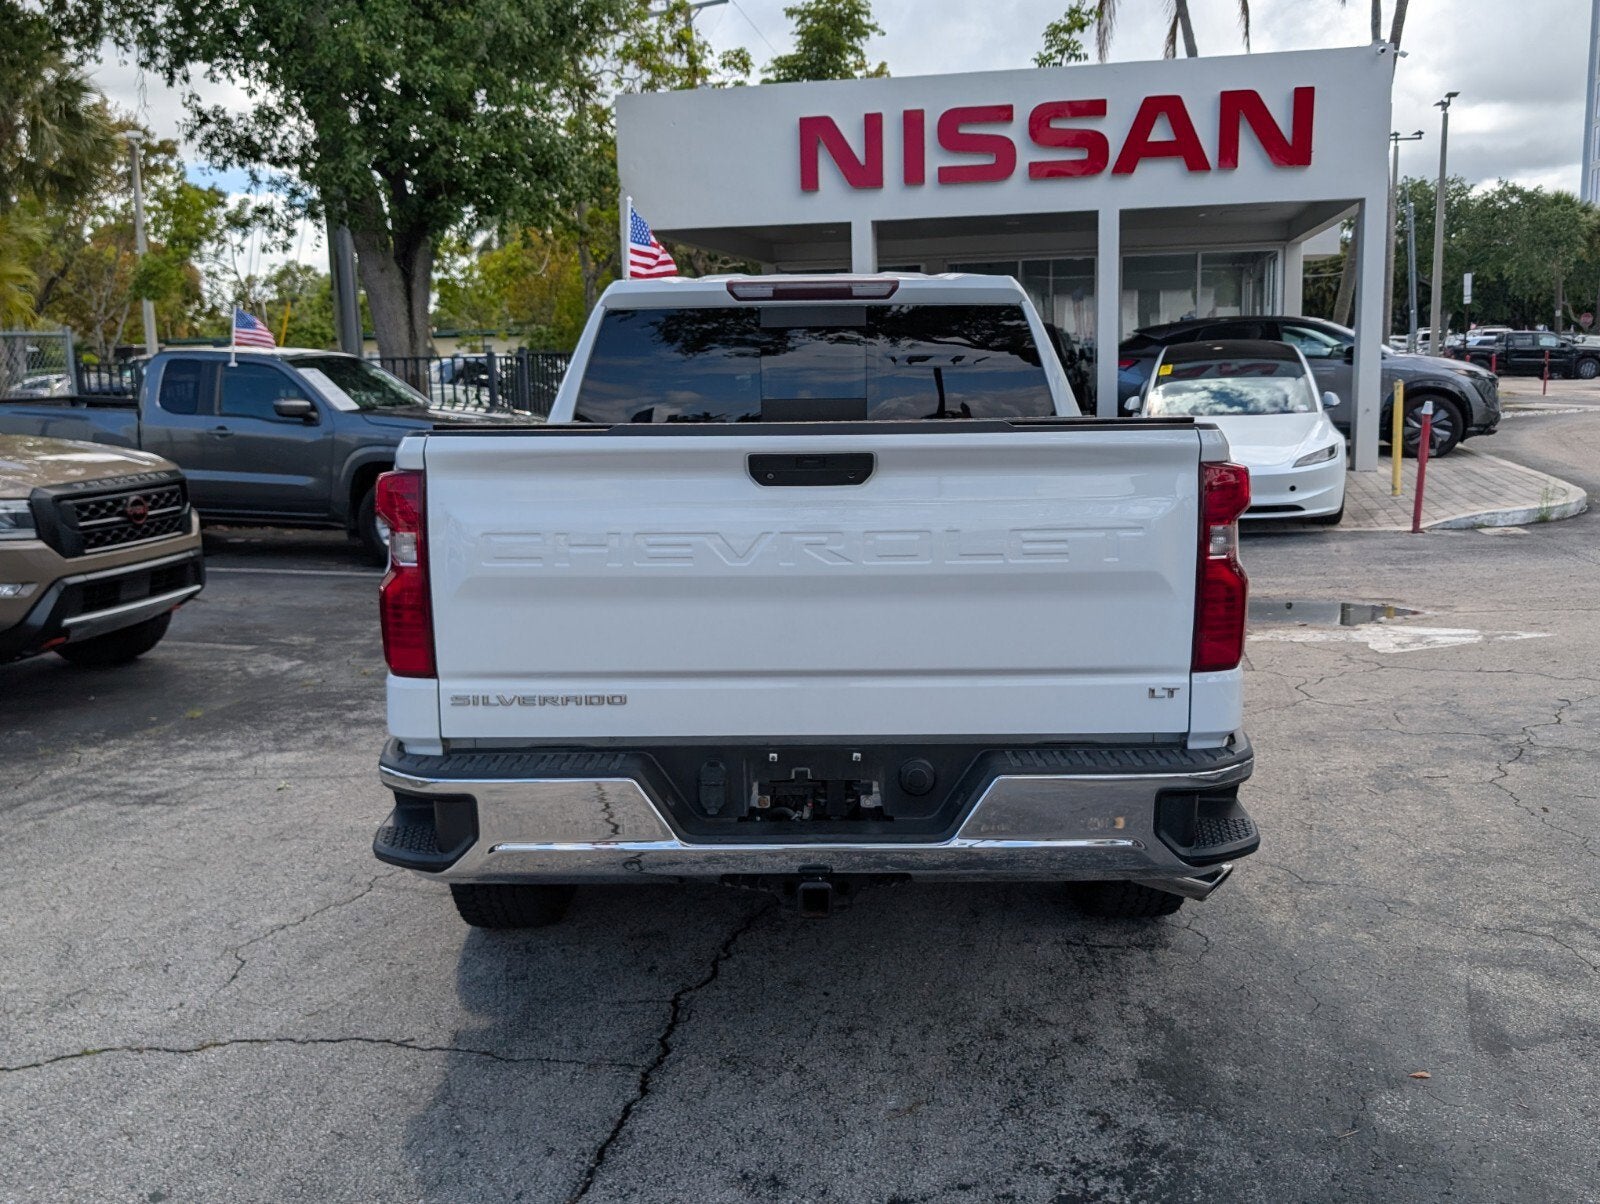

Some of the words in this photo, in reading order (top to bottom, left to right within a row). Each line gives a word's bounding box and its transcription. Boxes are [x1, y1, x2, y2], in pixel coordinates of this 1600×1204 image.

[799, 86, 1315, 192] NISSAN
[480, 526, 1146, 567] CHEVROLET
[450, 694, 628, 706] SILVERADO
[1148, 687, 1180, 699] LT
